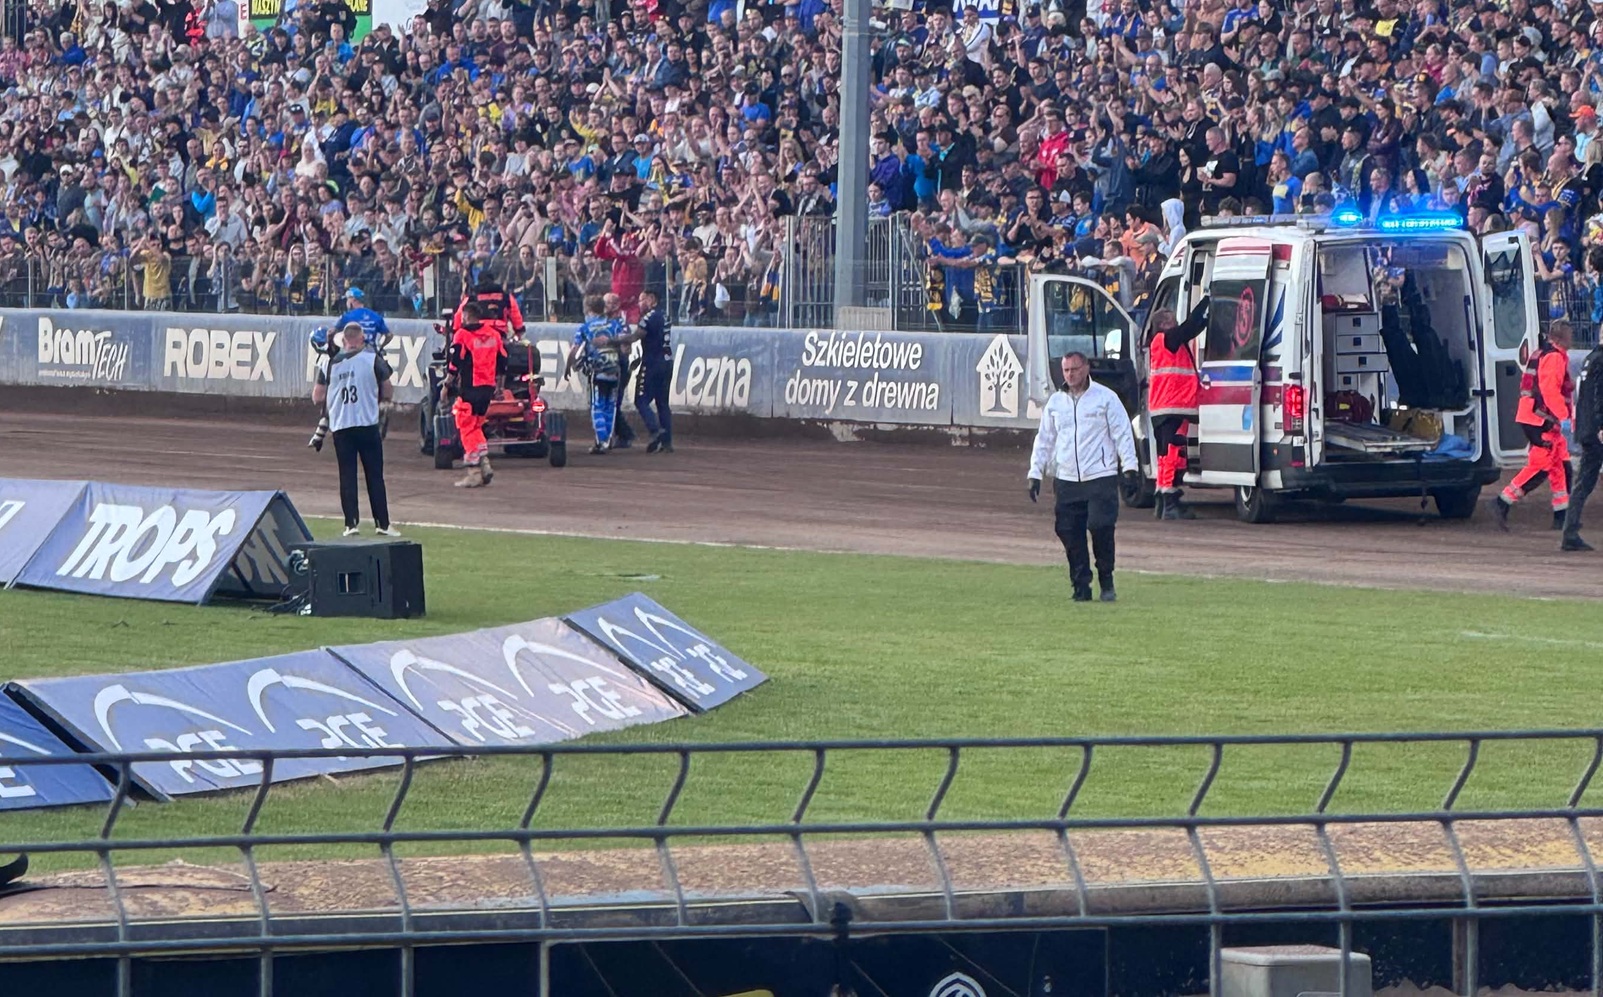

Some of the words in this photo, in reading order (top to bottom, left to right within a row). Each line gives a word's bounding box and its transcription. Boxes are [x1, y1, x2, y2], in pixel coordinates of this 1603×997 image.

[164, 328, 276, 381] ROBEX
[802, 330, 922, 370] Szkieletowe
[785, 369, 841, 414] domy
[844, 380, 858, 406] z
[862, 372, 939, 410] drewna
[56, 502, 236, 588] TROPS
